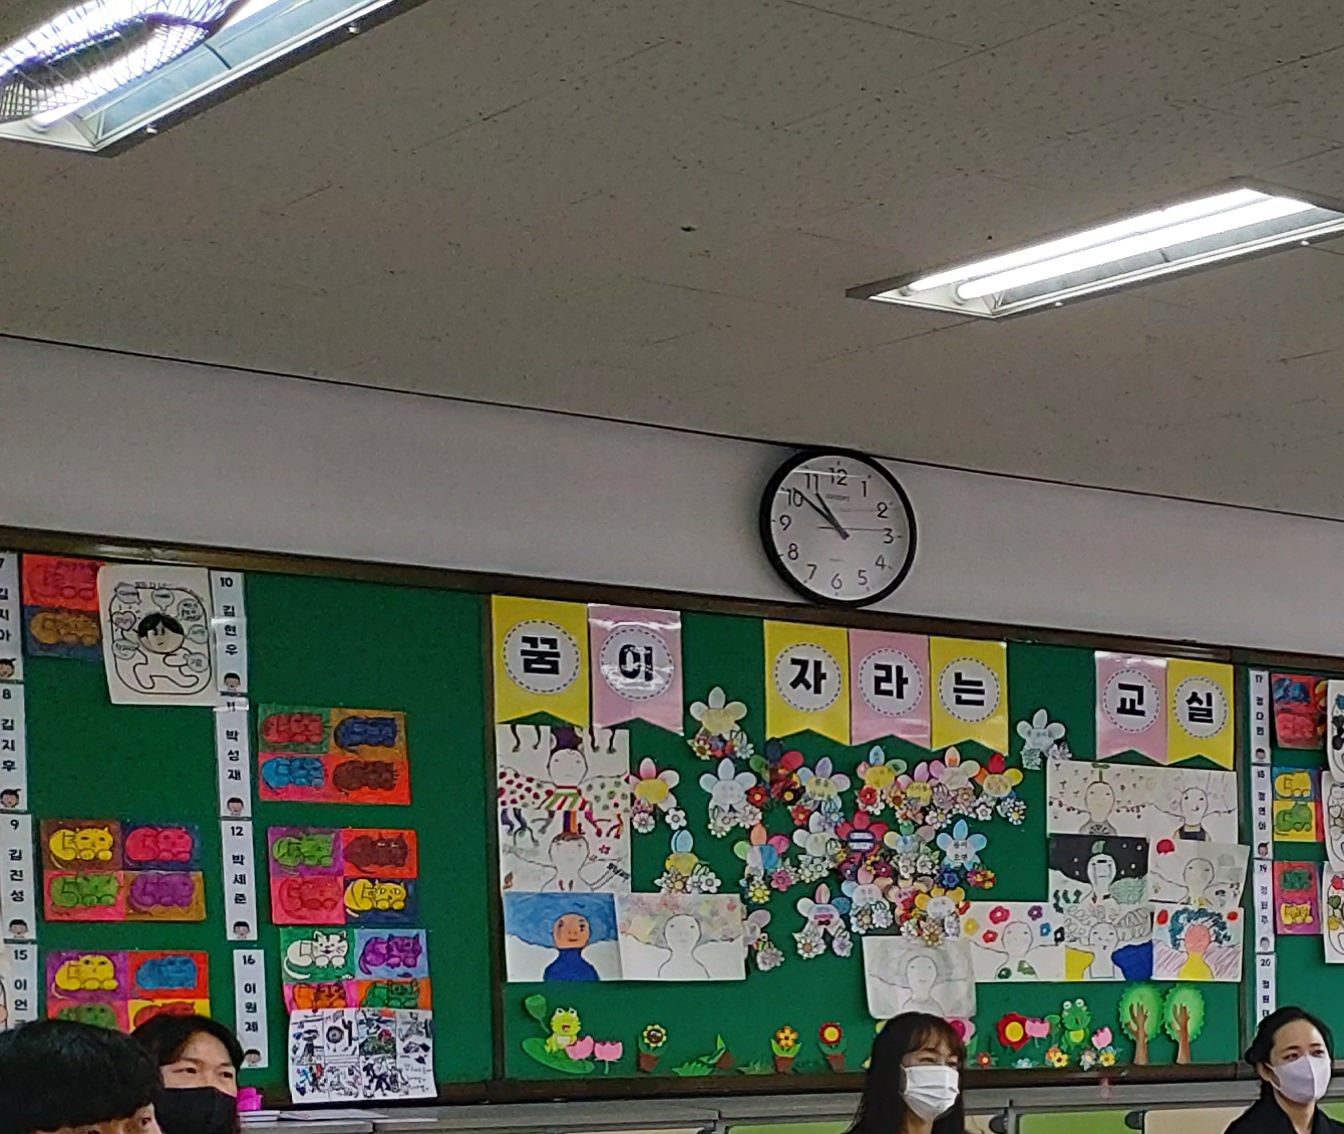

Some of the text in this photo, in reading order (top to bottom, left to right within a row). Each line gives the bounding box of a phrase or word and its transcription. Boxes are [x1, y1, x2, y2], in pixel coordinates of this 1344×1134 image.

[804, 472, 819, 491] 11
[828, 467, 848, 486] 12
[786, 488, 804, 507] 10
[861, 480, 868, 498] 1
[876, 501, 889, 519] 2
[779, 514, 792, 531] 9
[882, 527, 895, 544] 3
[787, 543, 799, 561] 8
[875, 554, 887, 570] 4
[806, 563, 818, 580] 7
[857, 569, 868, 586] 5
[219, 577, 234, 588] 10
[830, 572, 843, 590] 6
[520, 635, 1214, 725] 꿈이 자라는 교실
[2, 688, 12, 700] 8
[10, 818, 20, 830] 9
[229, 825, 244, 837] 12
[13, 949, 28, 961] 15
[242, 954, 256, 966] 16
[1260, 958, 1271, 967] 20
